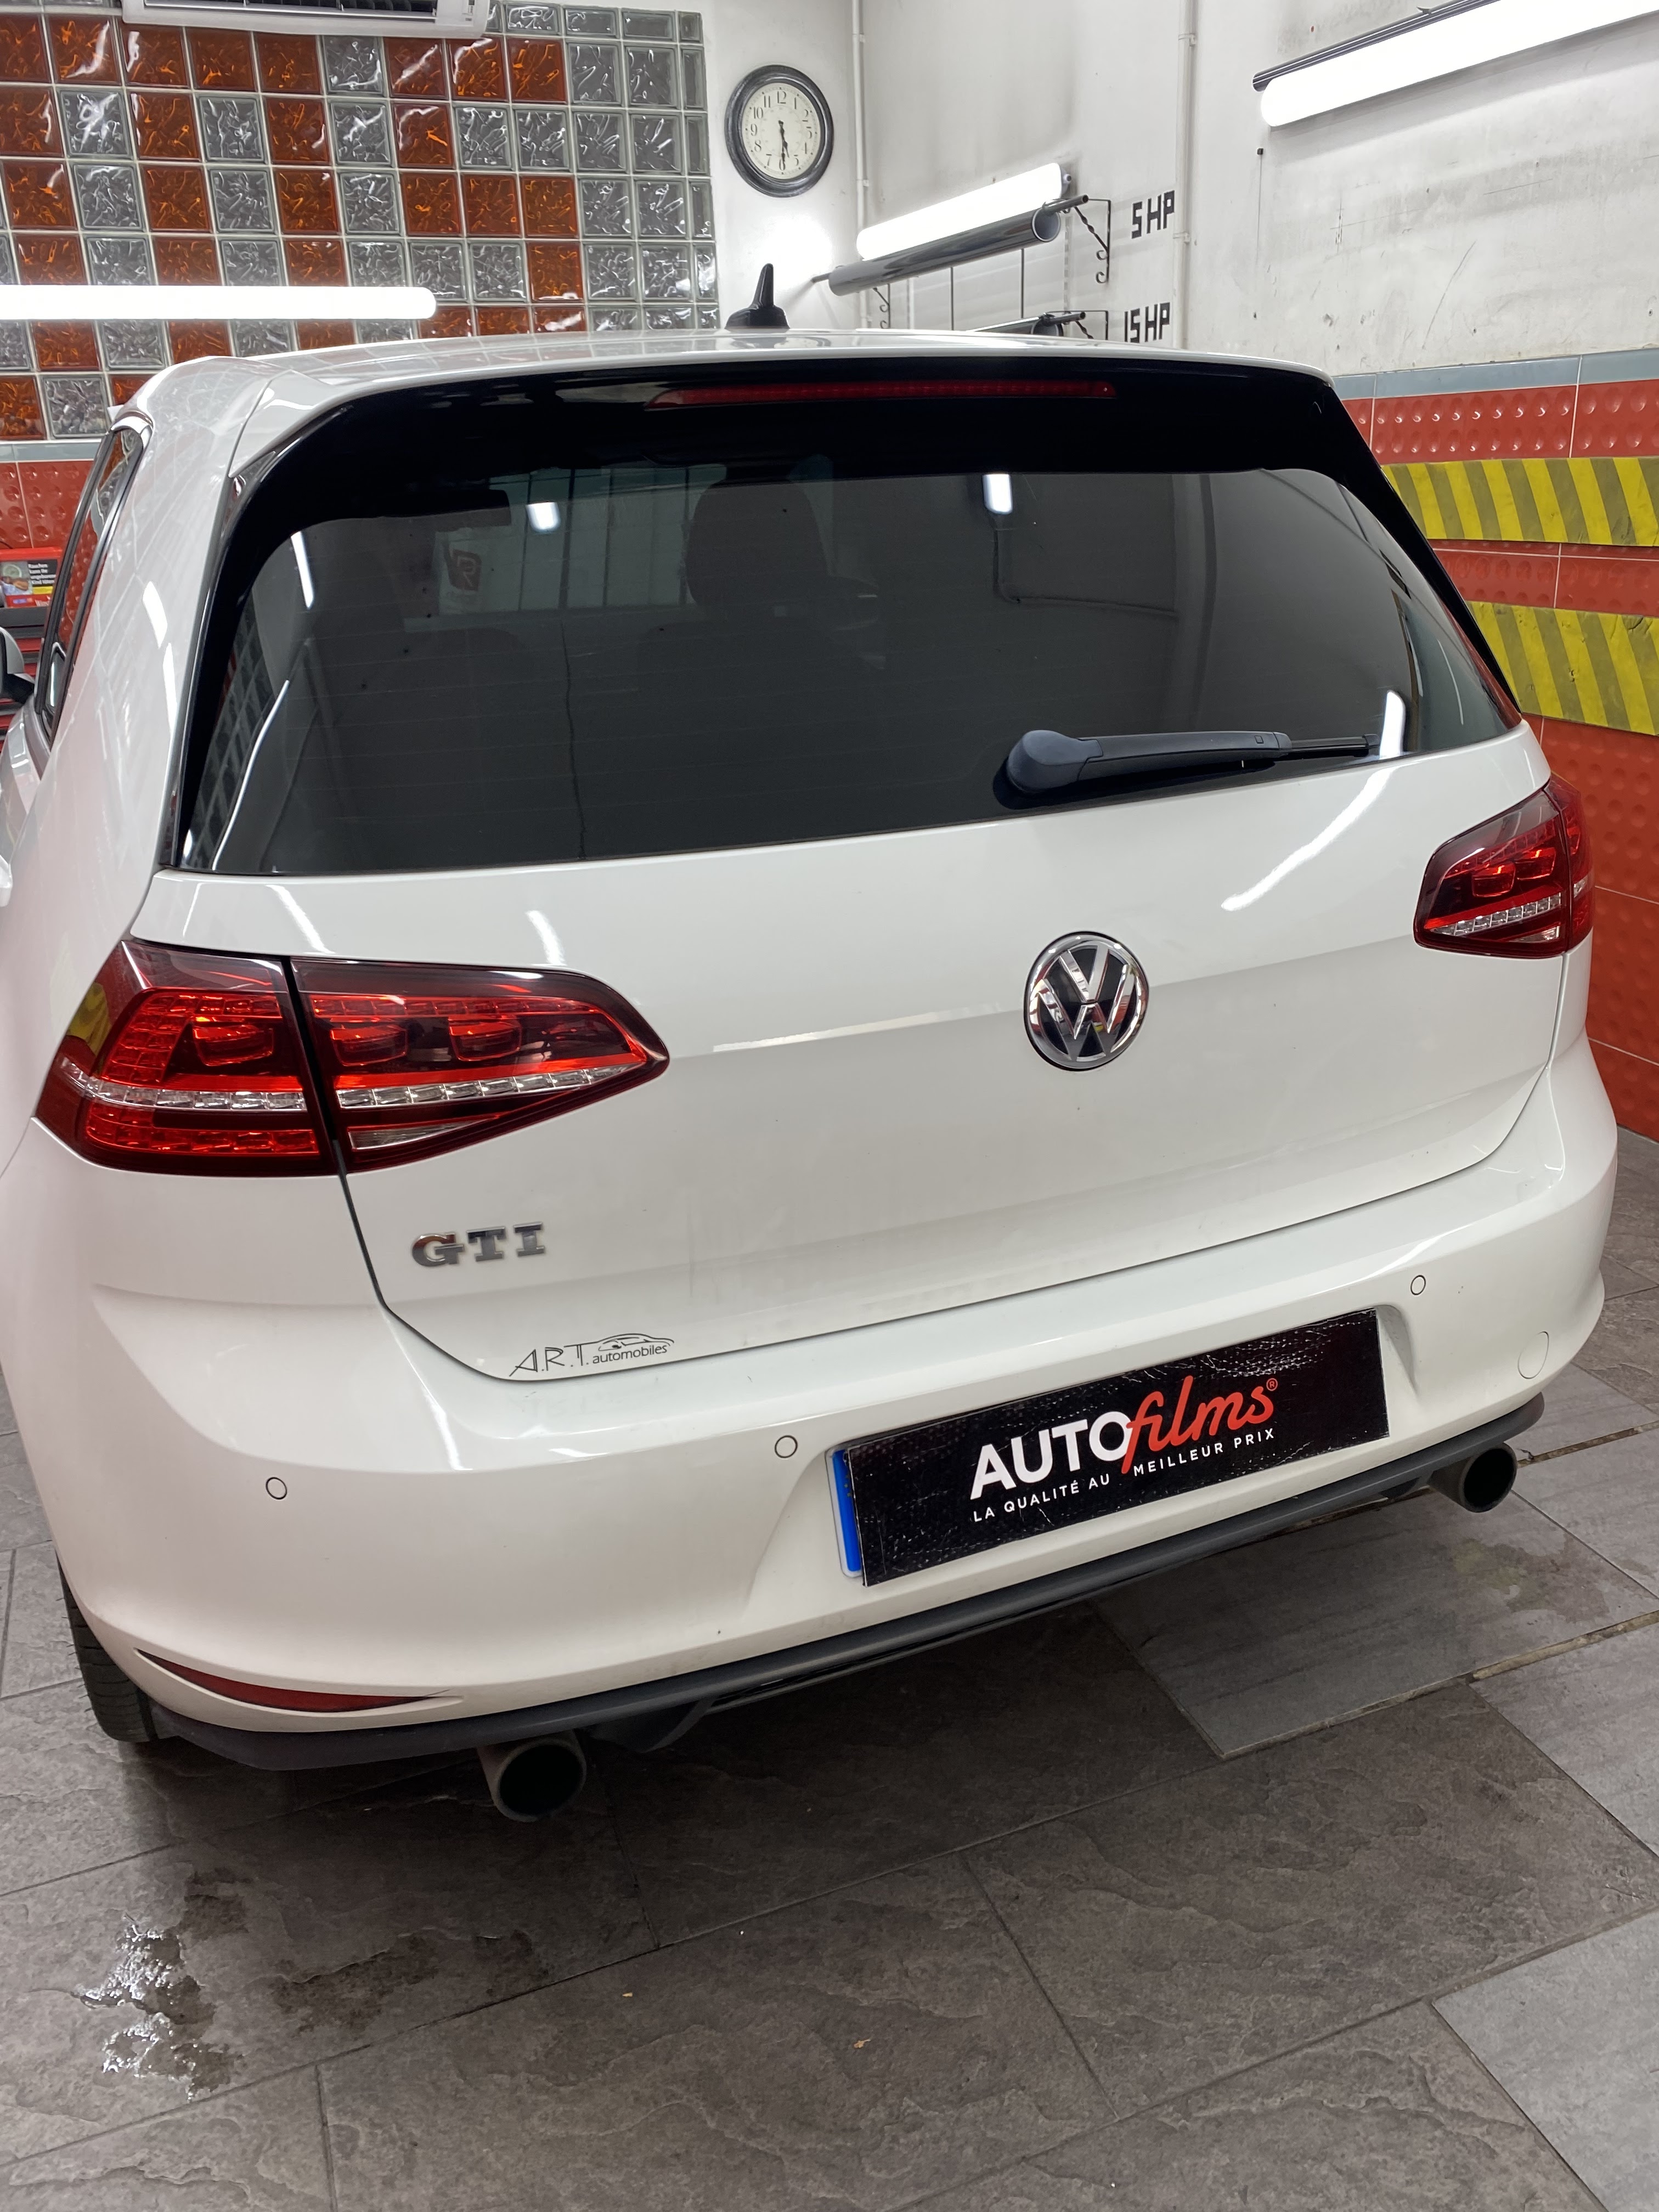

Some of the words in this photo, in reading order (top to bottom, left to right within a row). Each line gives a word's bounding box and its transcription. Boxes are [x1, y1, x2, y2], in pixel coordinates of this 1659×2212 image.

[764, 95, 771, 108] 11
[777, 91, 787, 104] 12
[753, 106, 764, 119] 10
[802, 109, 809, 122] 2
[751, 123, 758, 136] 9
[754, 139, 761, 152] 8
[766, 154, 772, 166] 7
[412, 1221, 545, 1267] GTI
[592, 1345, 668, 1364] automobiles
[973, 1506, 995, 1522] LA
[1003, 1480, 1080, 1513] QUALITÉ
[1088, 1473, 1110, 1490] AU
[1133, 1442, 1223, 1477] MEILLEUR
[1234, 1427, 1274, 1449] PRIX
